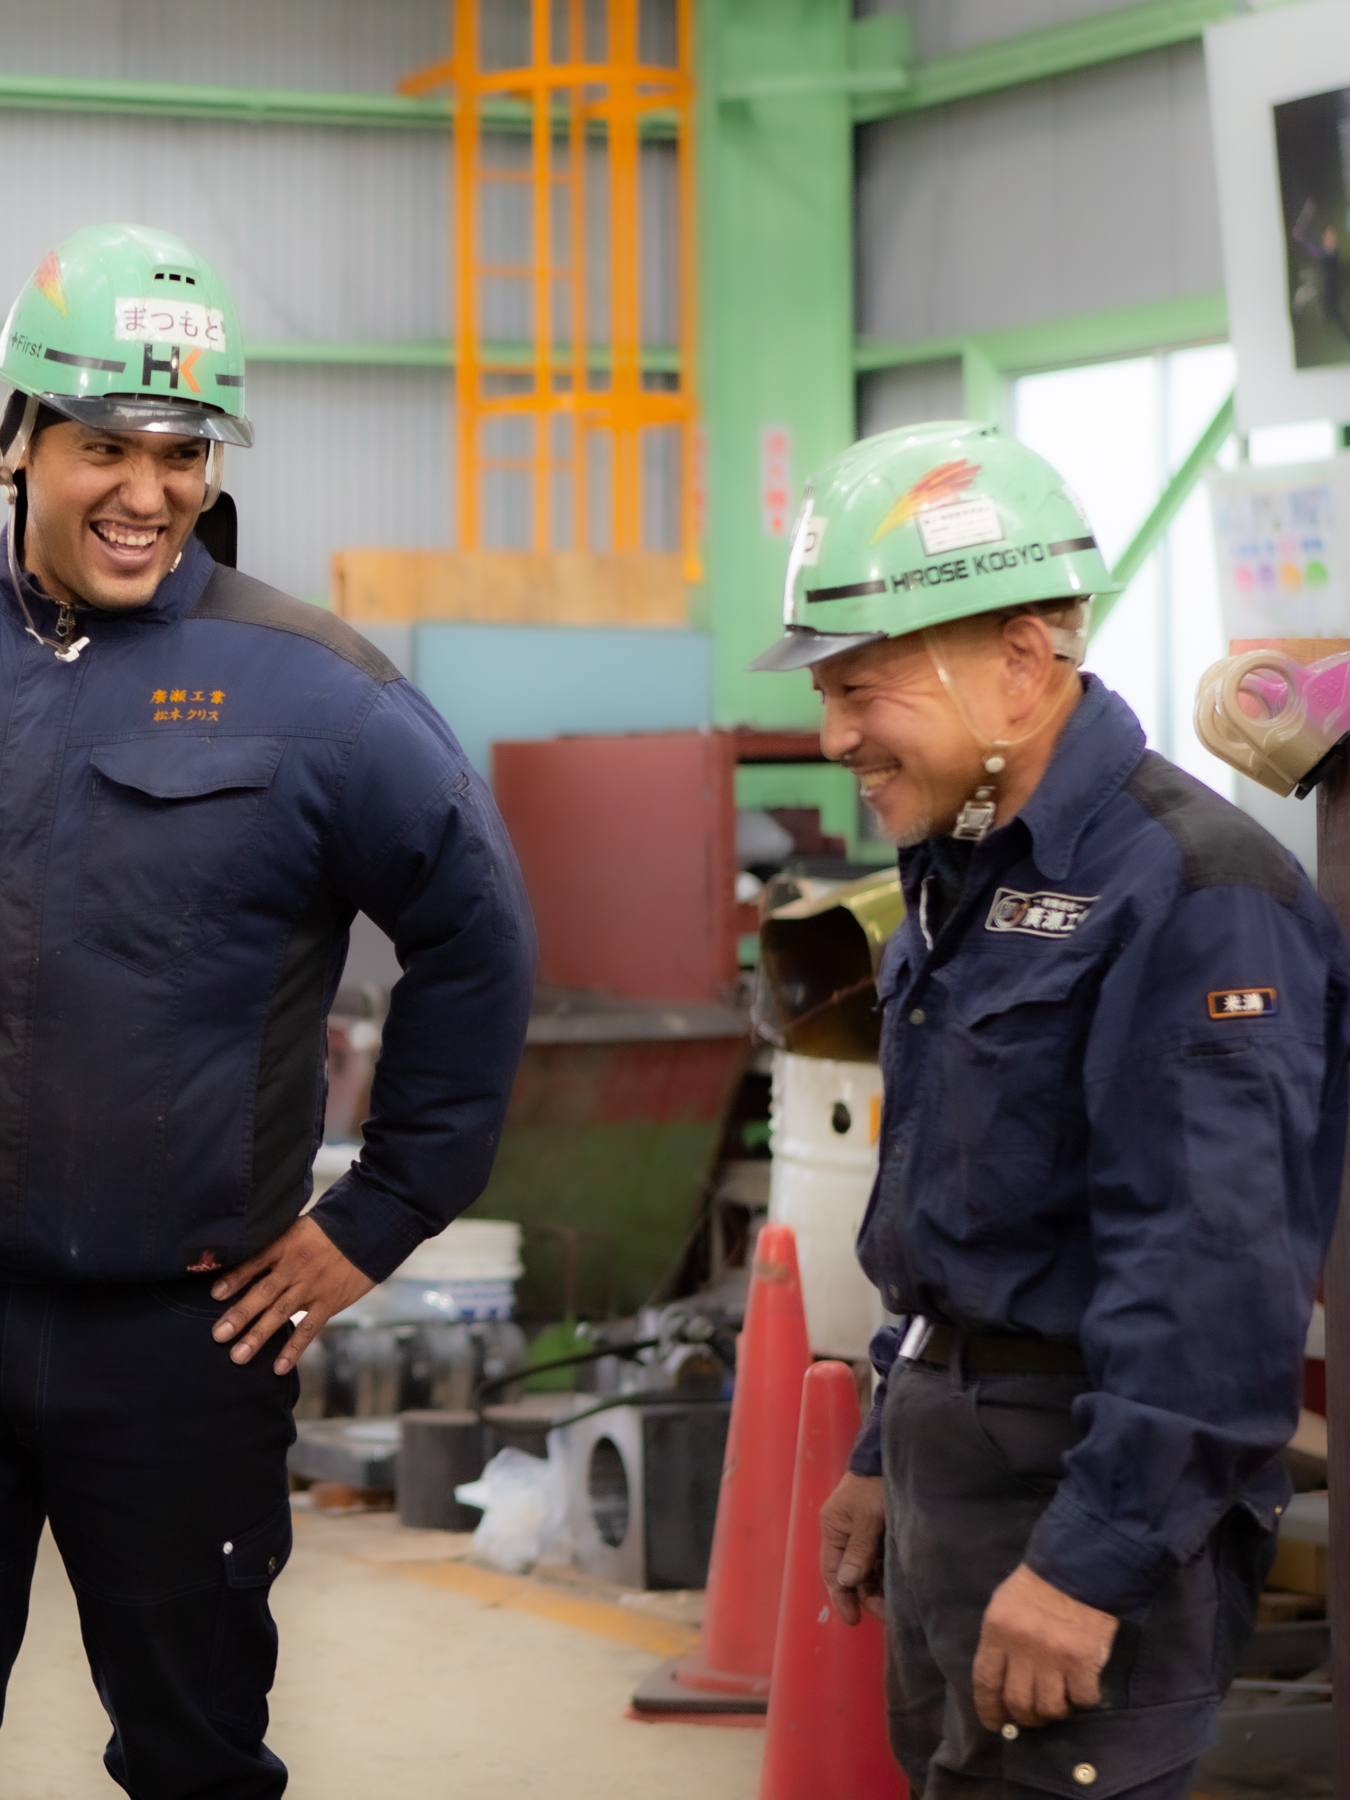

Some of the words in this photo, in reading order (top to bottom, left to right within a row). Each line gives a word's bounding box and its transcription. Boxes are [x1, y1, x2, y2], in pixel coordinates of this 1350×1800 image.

[123, 306, 218, 342] まつもと
[16, 334, 42, 358] First
[142, 343, 204, 394] HK
[891, 558, 969, 593] HIROSE
[972, 542, 1045, 576] KOGYO
